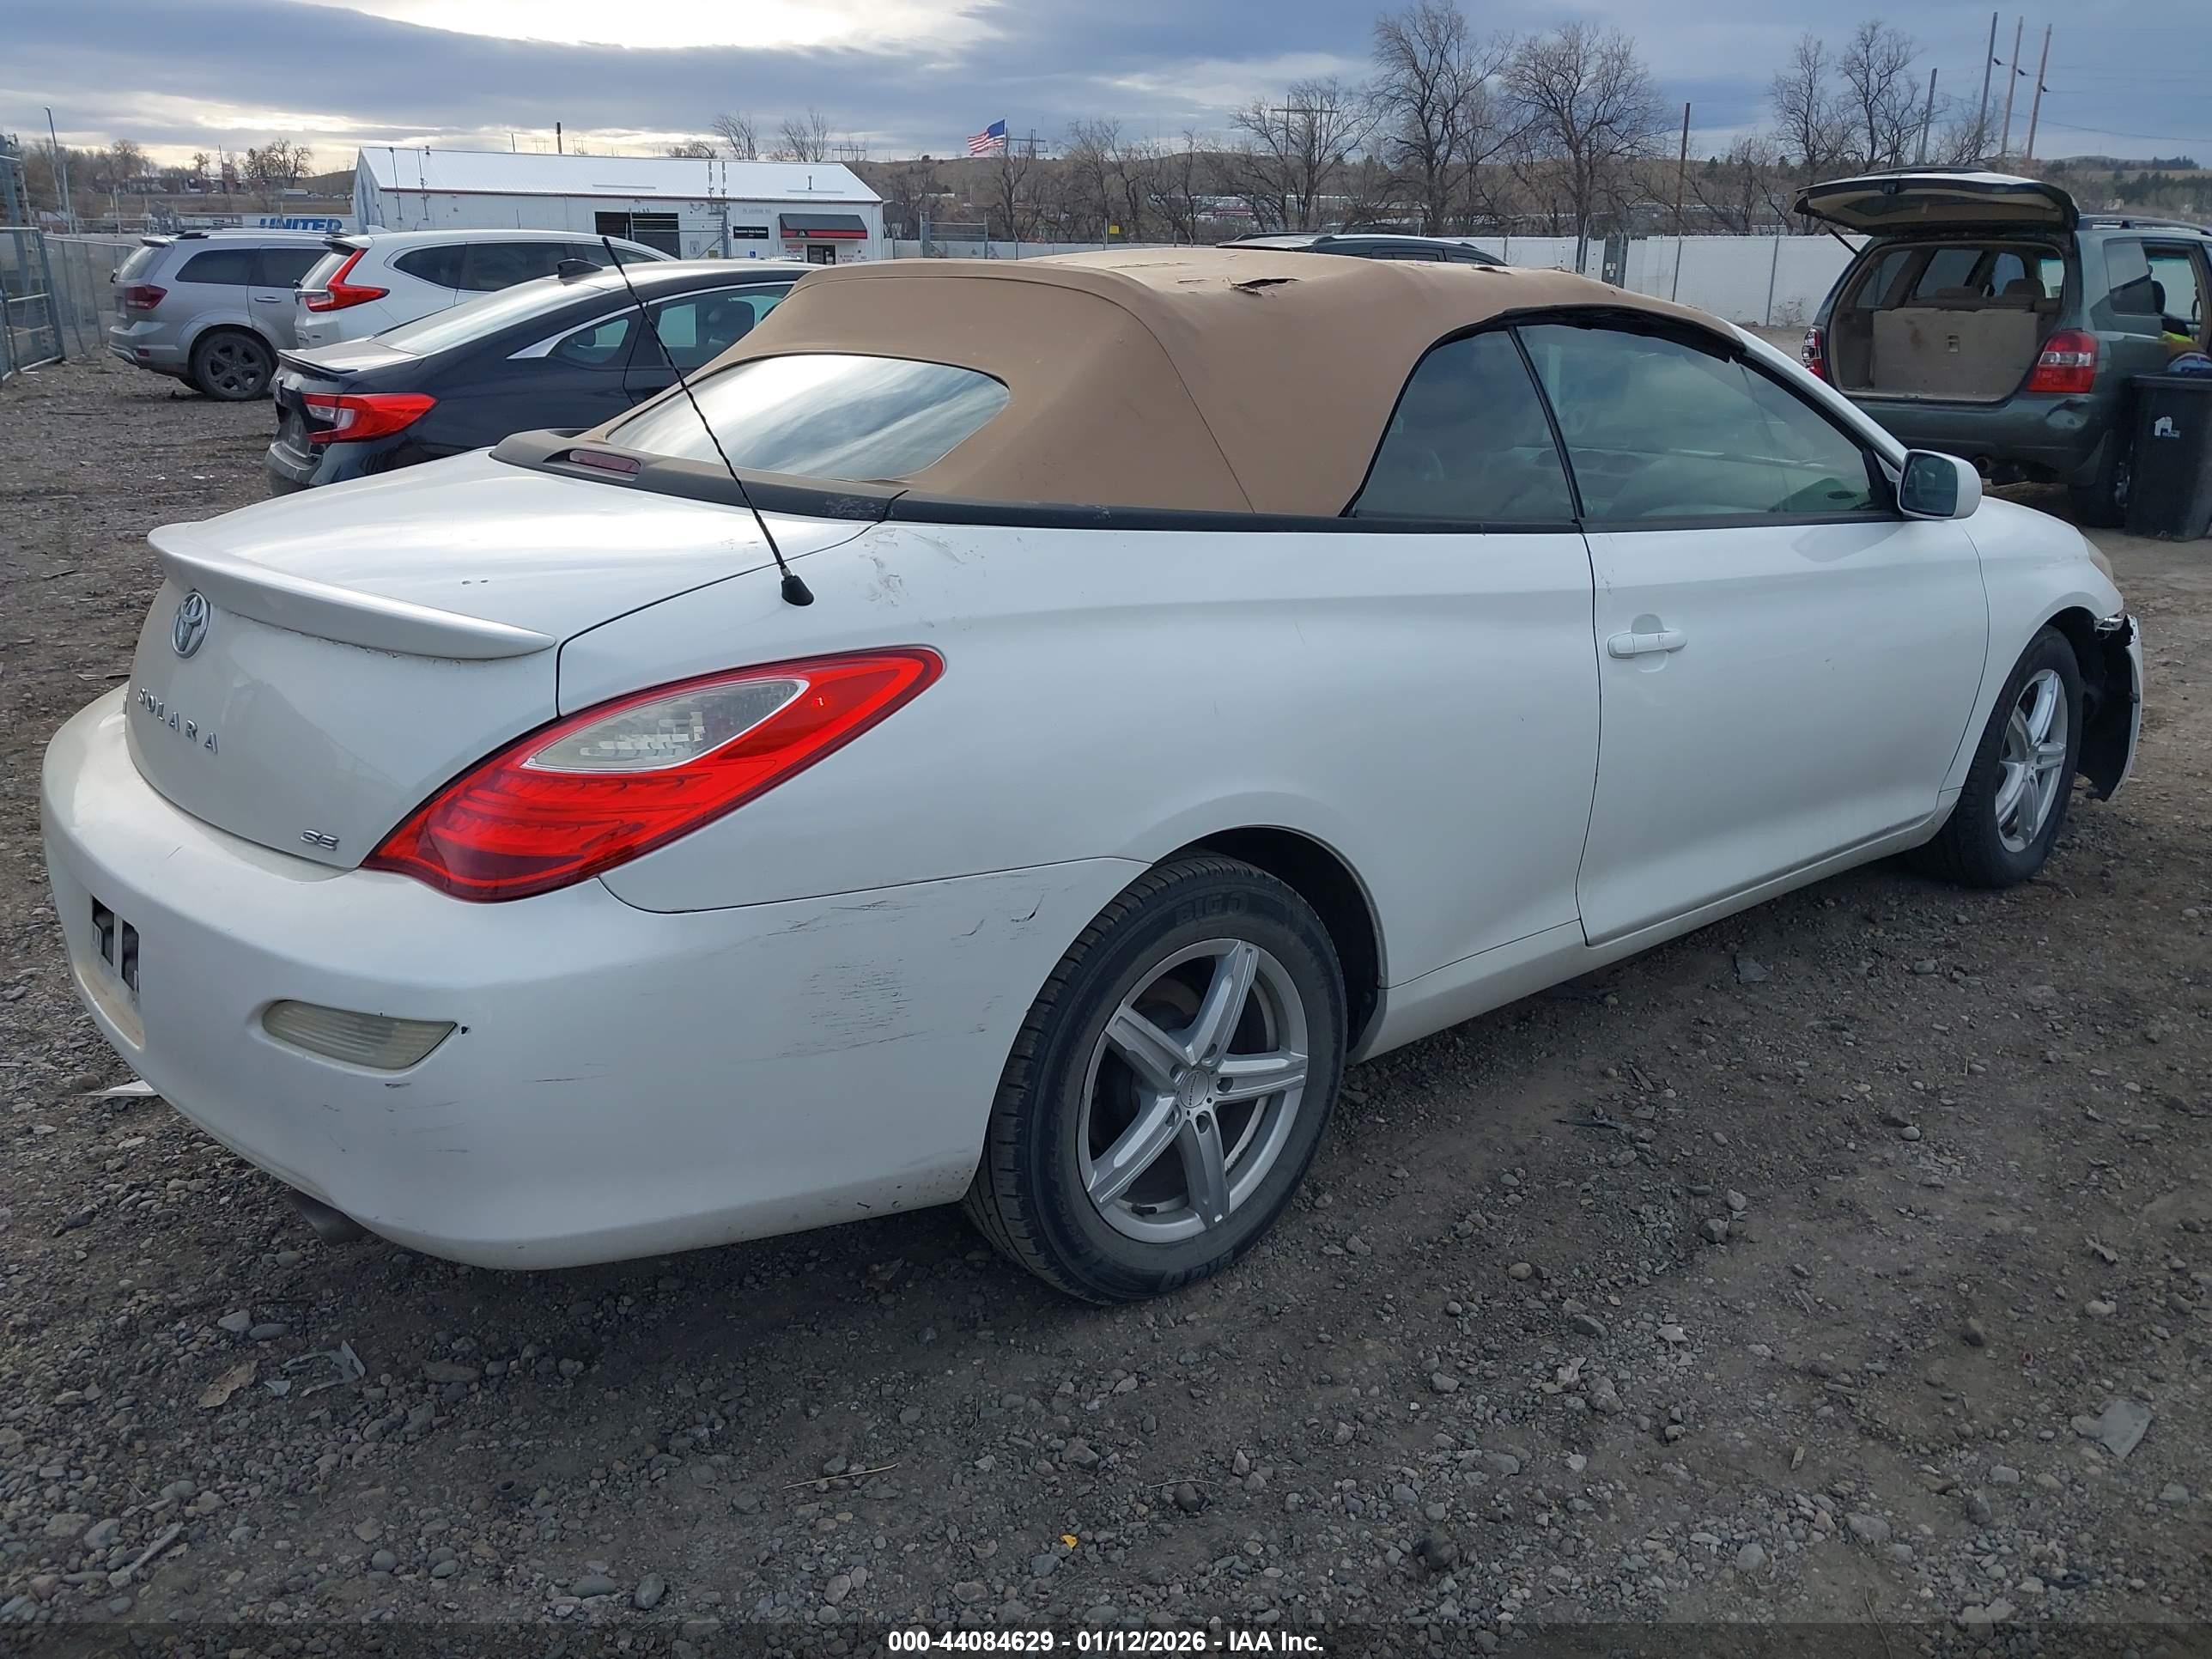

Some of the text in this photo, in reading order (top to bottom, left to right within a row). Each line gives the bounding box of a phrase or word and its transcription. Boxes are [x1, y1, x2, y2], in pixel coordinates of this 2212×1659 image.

[259, 218, 343, 233] UNITED
[137, 687, 219, 756] SOLARA
[301, 830, 339, 851] SE
